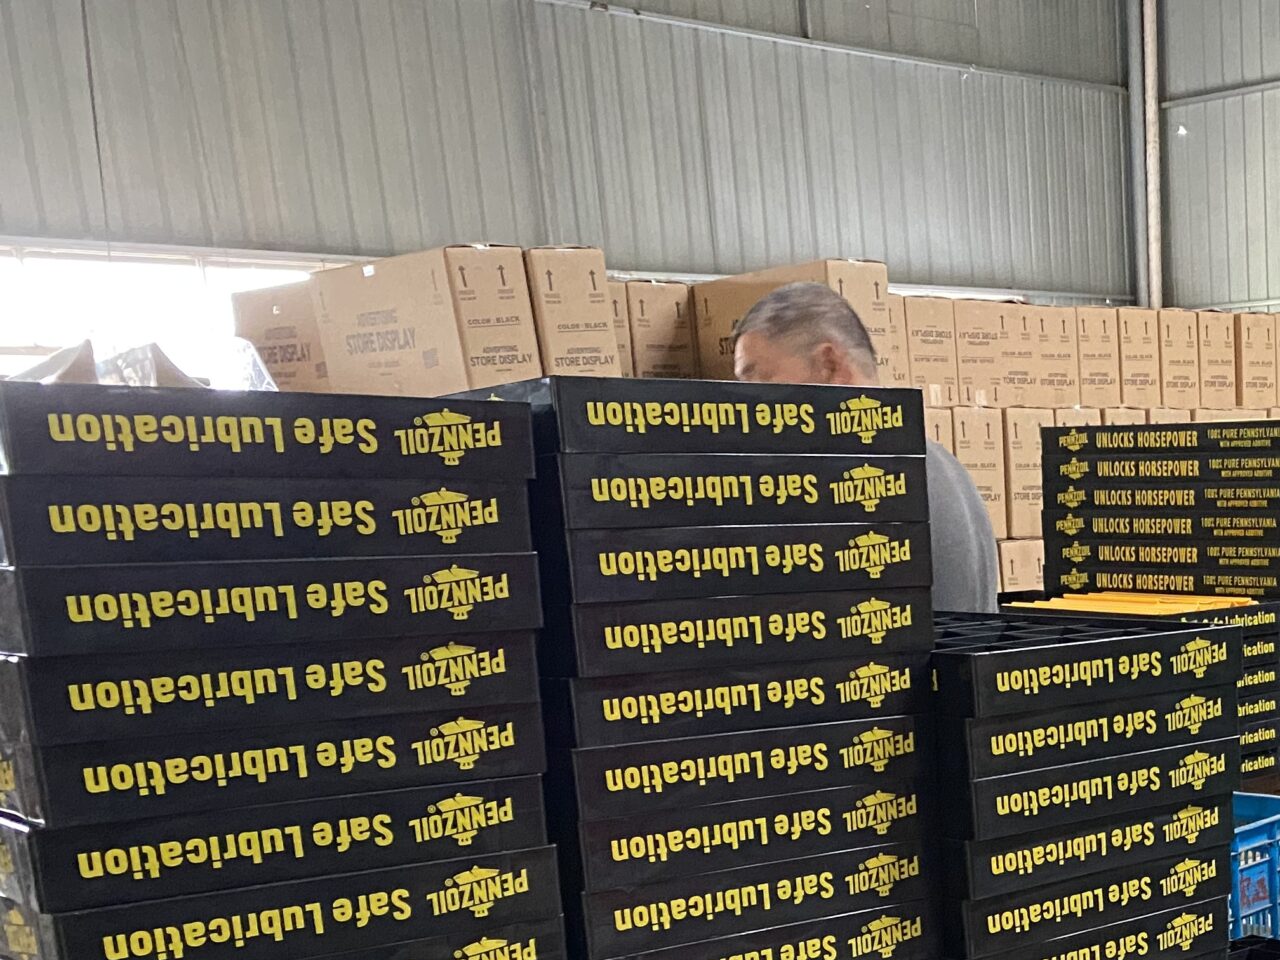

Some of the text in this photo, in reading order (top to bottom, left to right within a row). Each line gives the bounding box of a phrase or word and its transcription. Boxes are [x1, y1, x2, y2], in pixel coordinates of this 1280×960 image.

[495, 315, 521, 324] BLACK
[346, 327, 416, 356] STORE DISPLAY
[470, 353, 532, 367] STORE DISPLAY
[554, 354, 615, 367] STORE DISPLAY
[587, 401, 904, 434] PENNZOIL Safe Lubrication
[49, 415, 502, 456] PENNZOIL Safe Lubrication
[1096, 432, 1133, 449] UNLOCKS
[1137, 430, 1198, 449] HORSEPOWER
[1223, 458, 1239, 468] PURE
[1098, 546, 1135, 563] UNLOCKS
[1139, 546, 1198, 564] HORSEPOWER
[65, 575, 510, 629] PENNZOIL Safe Lubrication
[605, 607, 913, 654] PENNZOIL Safe Lubrication
[996, 645, 1227, 693] PENNZOIL Safe Lubrication
[83, 723, 515, 796] PENNZOIL Safe Lubrication
[990, 811, 1219, 875] PENNZOIL Safe Lubrication
[614, 859, 919, 932] PENNZOIL Safe Lubrication
